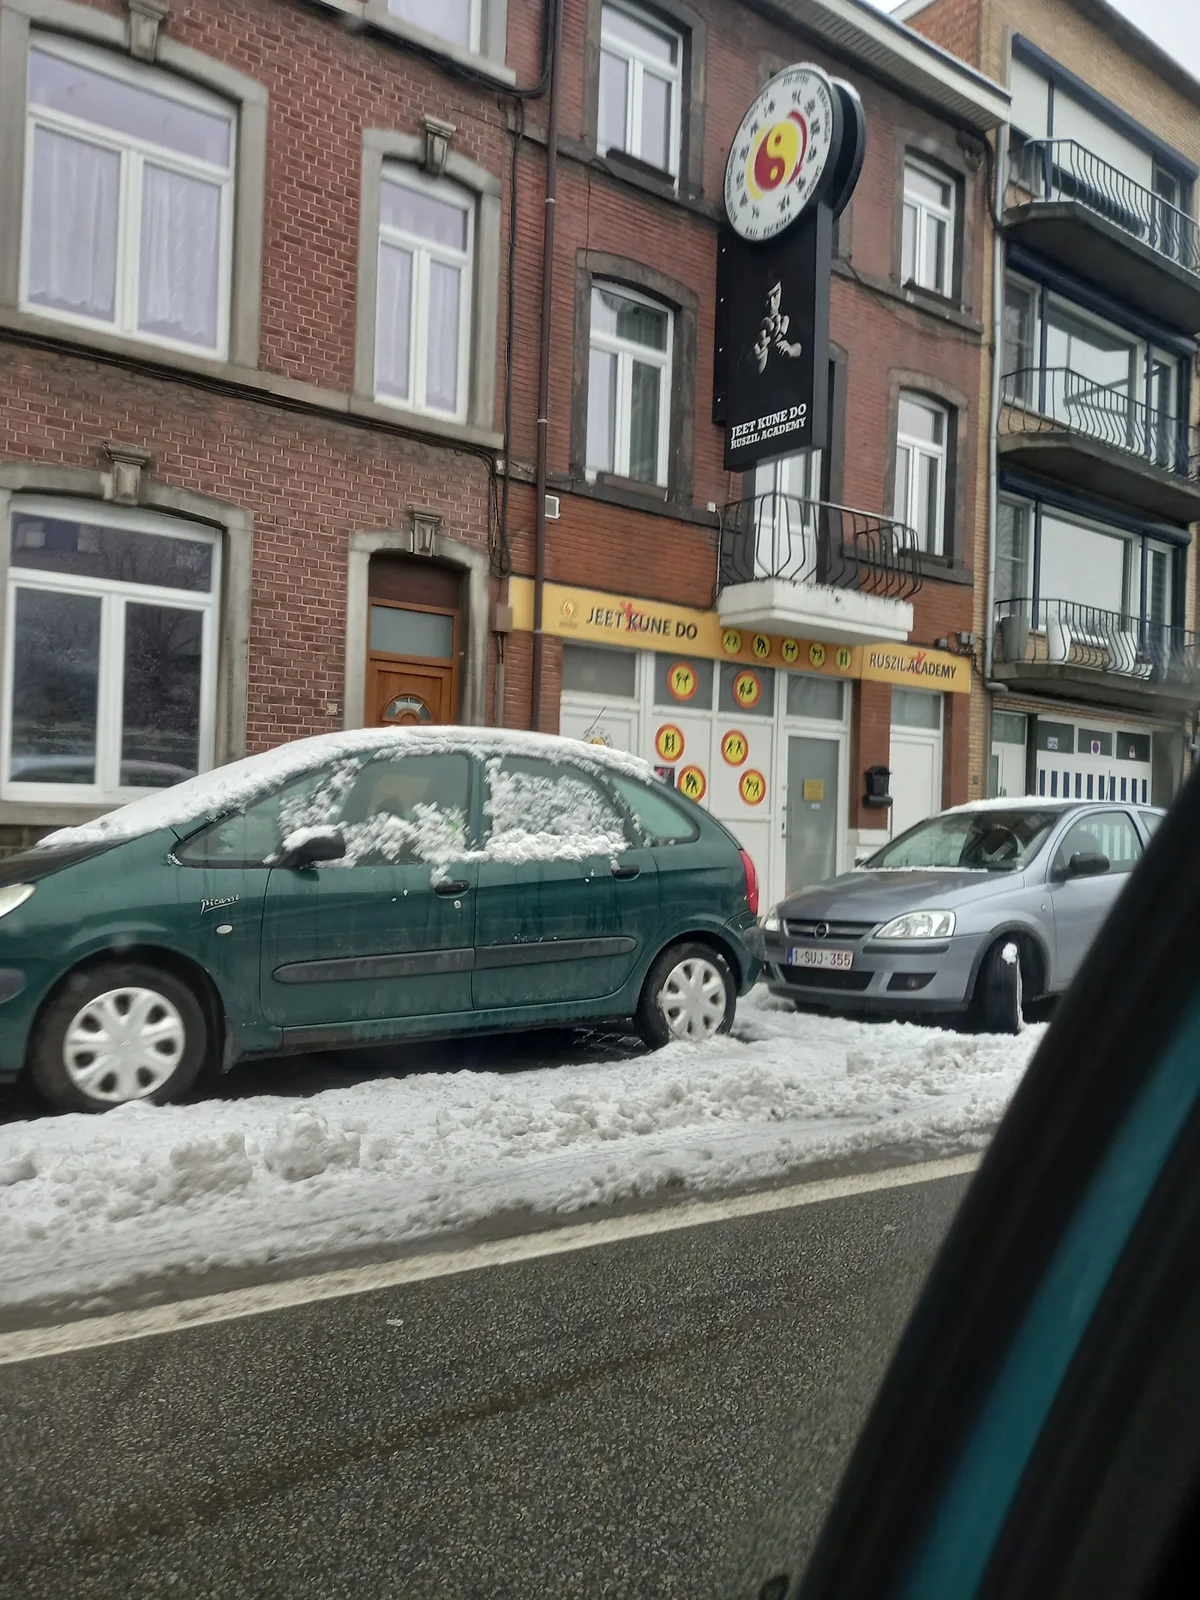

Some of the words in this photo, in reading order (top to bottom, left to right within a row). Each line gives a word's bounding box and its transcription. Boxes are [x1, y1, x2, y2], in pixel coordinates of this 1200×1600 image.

[730, 432, 760, 450] RUSZIL
[761, 417, 806, 440] ACADEMY
[731, 420, 756, 440] JEET
[757, 409, 788, 430] KUNE
[789, 403, 807, 419] DO
[586, 607, 623, 629] JEET
[628, 613, 671, 636] KUNE
[675, 622, 698, 640] DO
[869, 652, 905, 671] RUSZIL
[907, 658, 957, 679] ACADEMY
